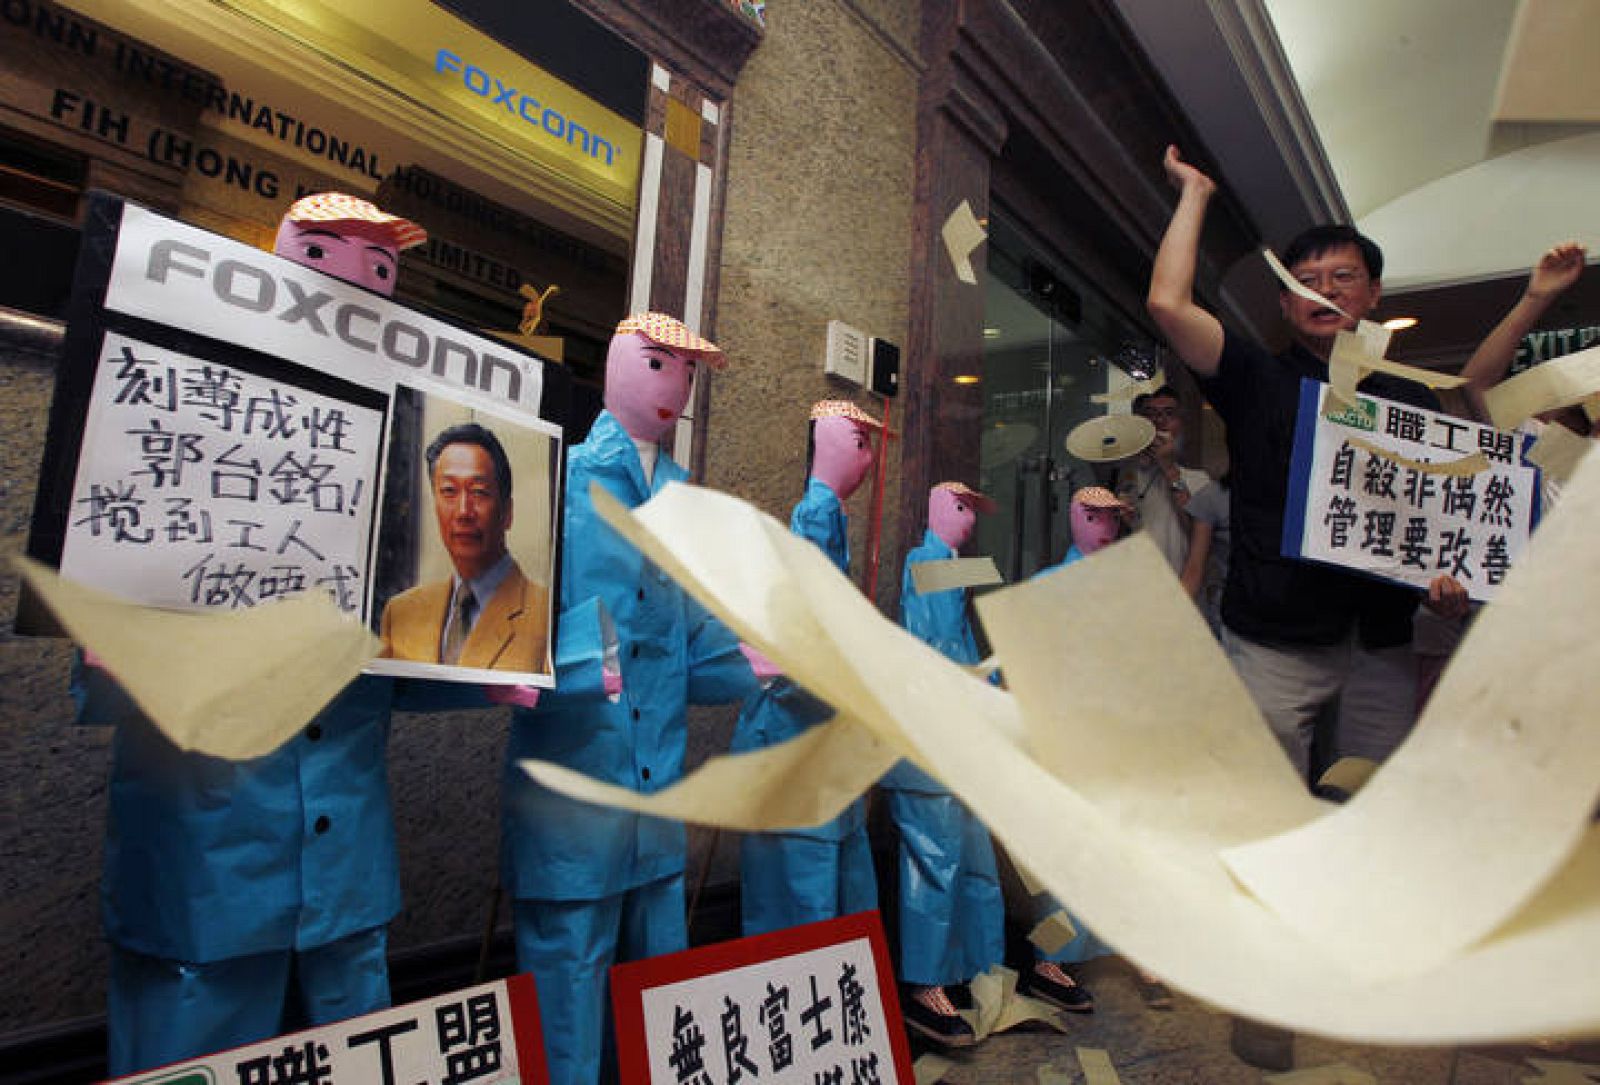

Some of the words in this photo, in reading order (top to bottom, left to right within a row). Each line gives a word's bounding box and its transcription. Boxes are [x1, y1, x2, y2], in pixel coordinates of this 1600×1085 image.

[115, 43, 383, 182] INTERNATIONAL
[434, 48, 614, 166] FOXCONN
[51, 88, 129, 143] FIH
[149, 129, 279, 199] (HONG
[428, 238, 523, 290] IMITED
[146, 239, 522, 404] FOXCONN
[108, 347, 356, 454] 刻薄成性
[1385, 406, 1514, 464] 職工盟
[126, 418, 364, 516] 郭台銘!
[1330, 441, 1515, 529] 自殺非偶然
[1324, 496, 1512, 585] 管理要改善
[669, 962, 871, 1085] 無良富士康
